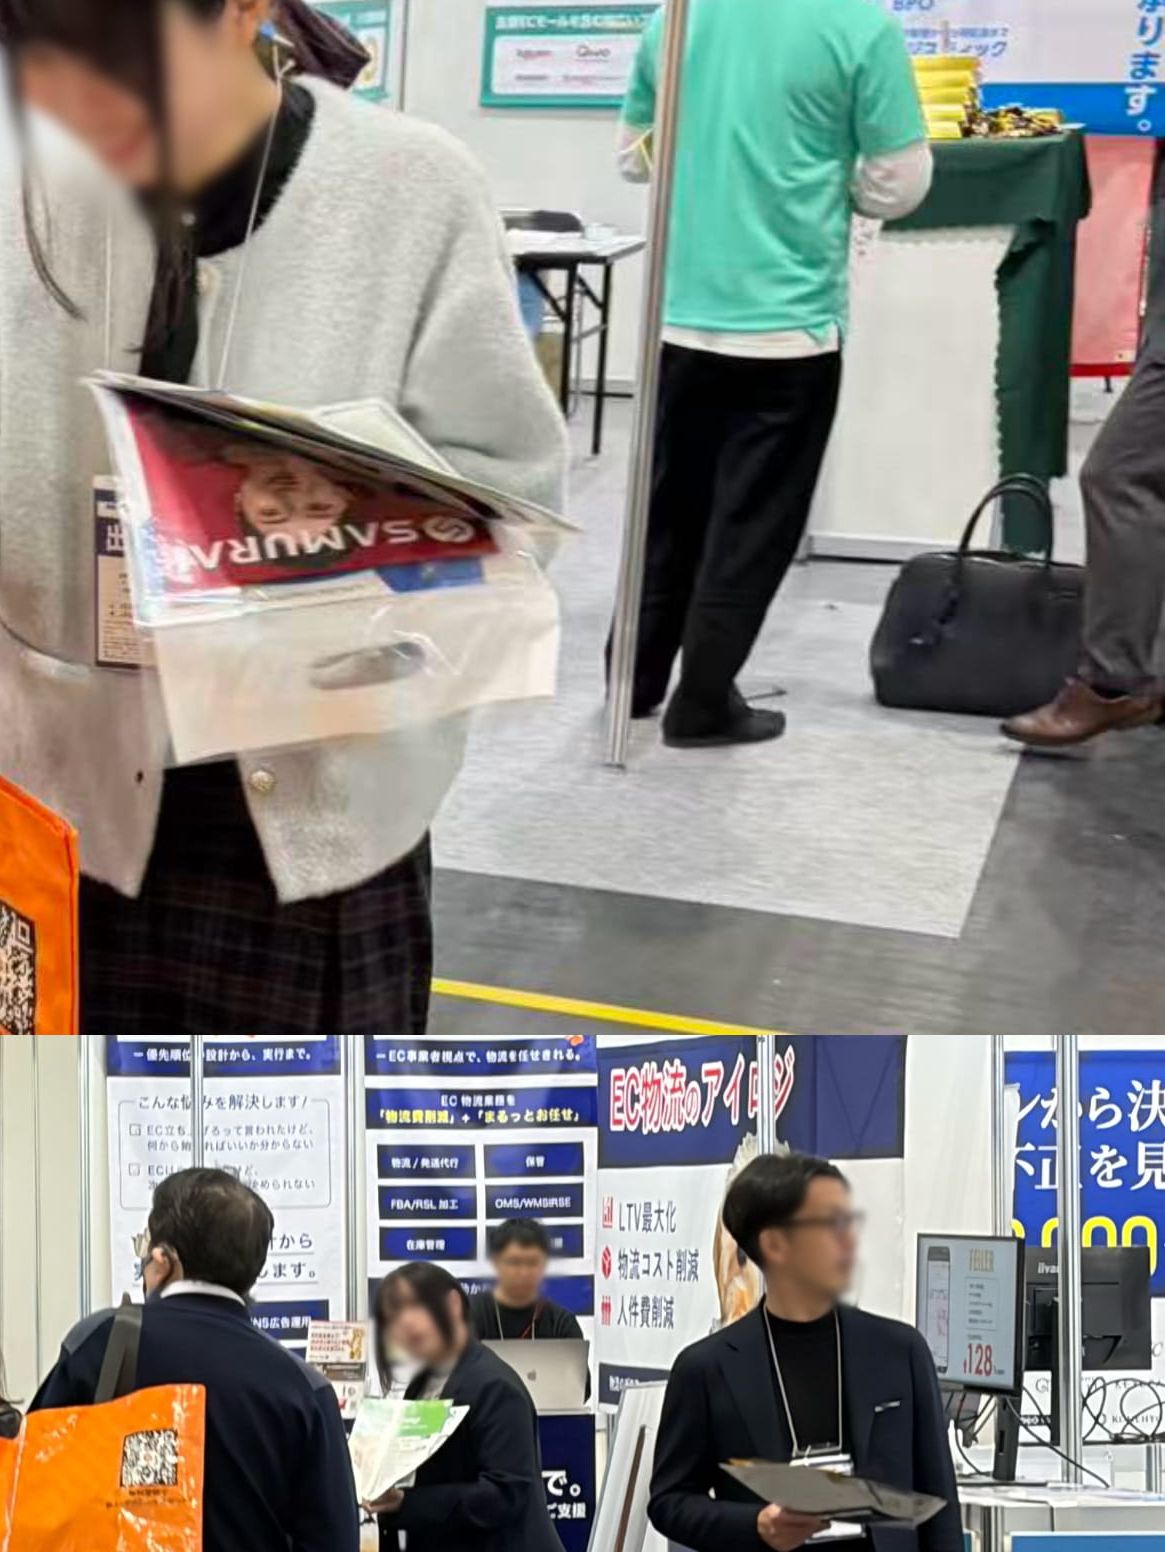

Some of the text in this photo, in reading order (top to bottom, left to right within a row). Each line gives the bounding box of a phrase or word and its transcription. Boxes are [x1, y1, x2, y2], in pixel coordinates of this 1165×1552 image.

[176, 518, 419, 573] SAMURA
[146, 1047, 312, 1062] 優先順位設計から、実行まで。
[147, 1139, 314, 1152] 何から始ればいいか分からない
[618, 1200, 677, 1233] LTV最大化
[617, 1247, 700, 1283] 物流コスト削減
[251, 1316, 312, 1330] NS広告運用
[616, 1295, 675, 1330] 人件費削減
